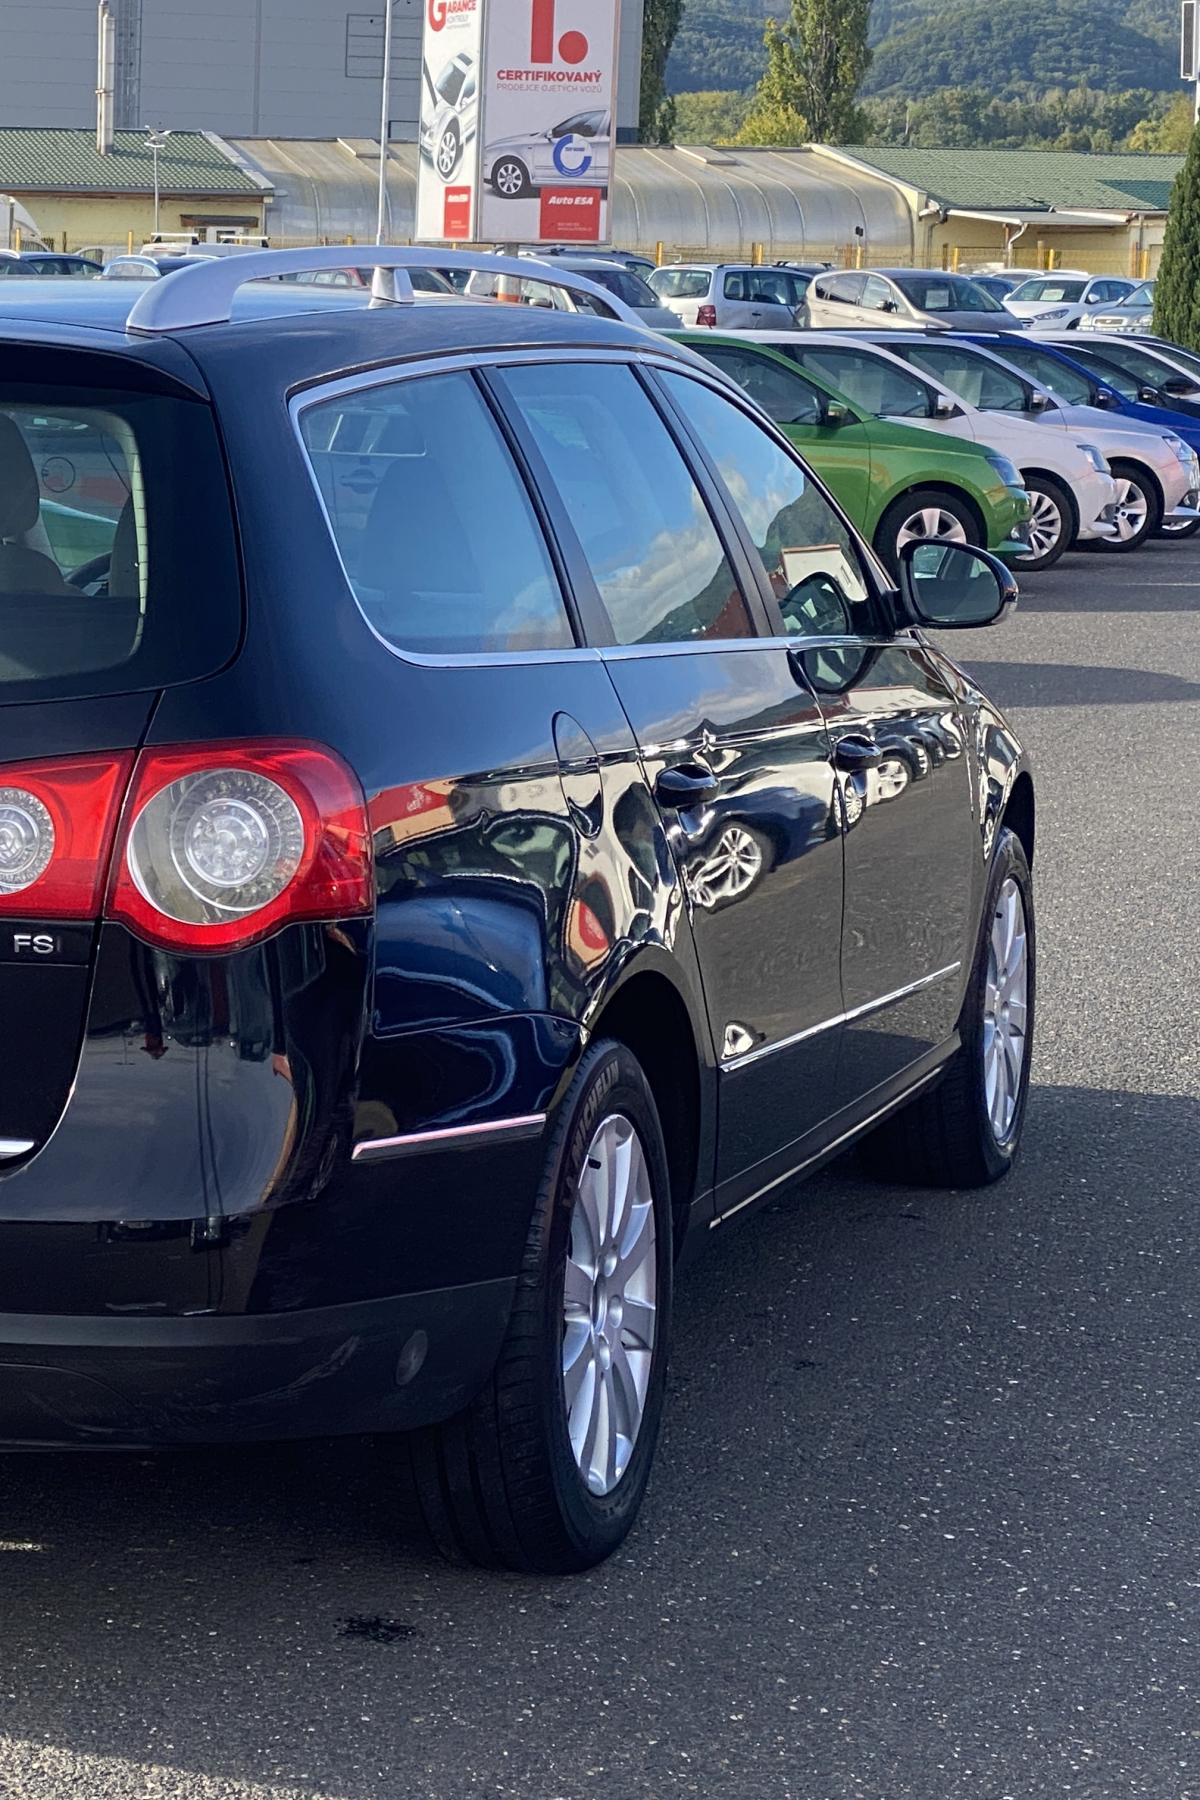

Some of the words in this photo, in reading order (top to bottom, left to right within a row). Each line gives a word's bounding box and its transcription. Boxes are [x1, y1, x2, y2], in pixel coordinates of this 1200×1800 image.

[496, 69, 602, 83] CERTIFIKOVANÝ
[496, 82, 539, 93] PRODEJCE
[548, 195, 573, 205] Auto
[574, 196, 594, 205] ESA
